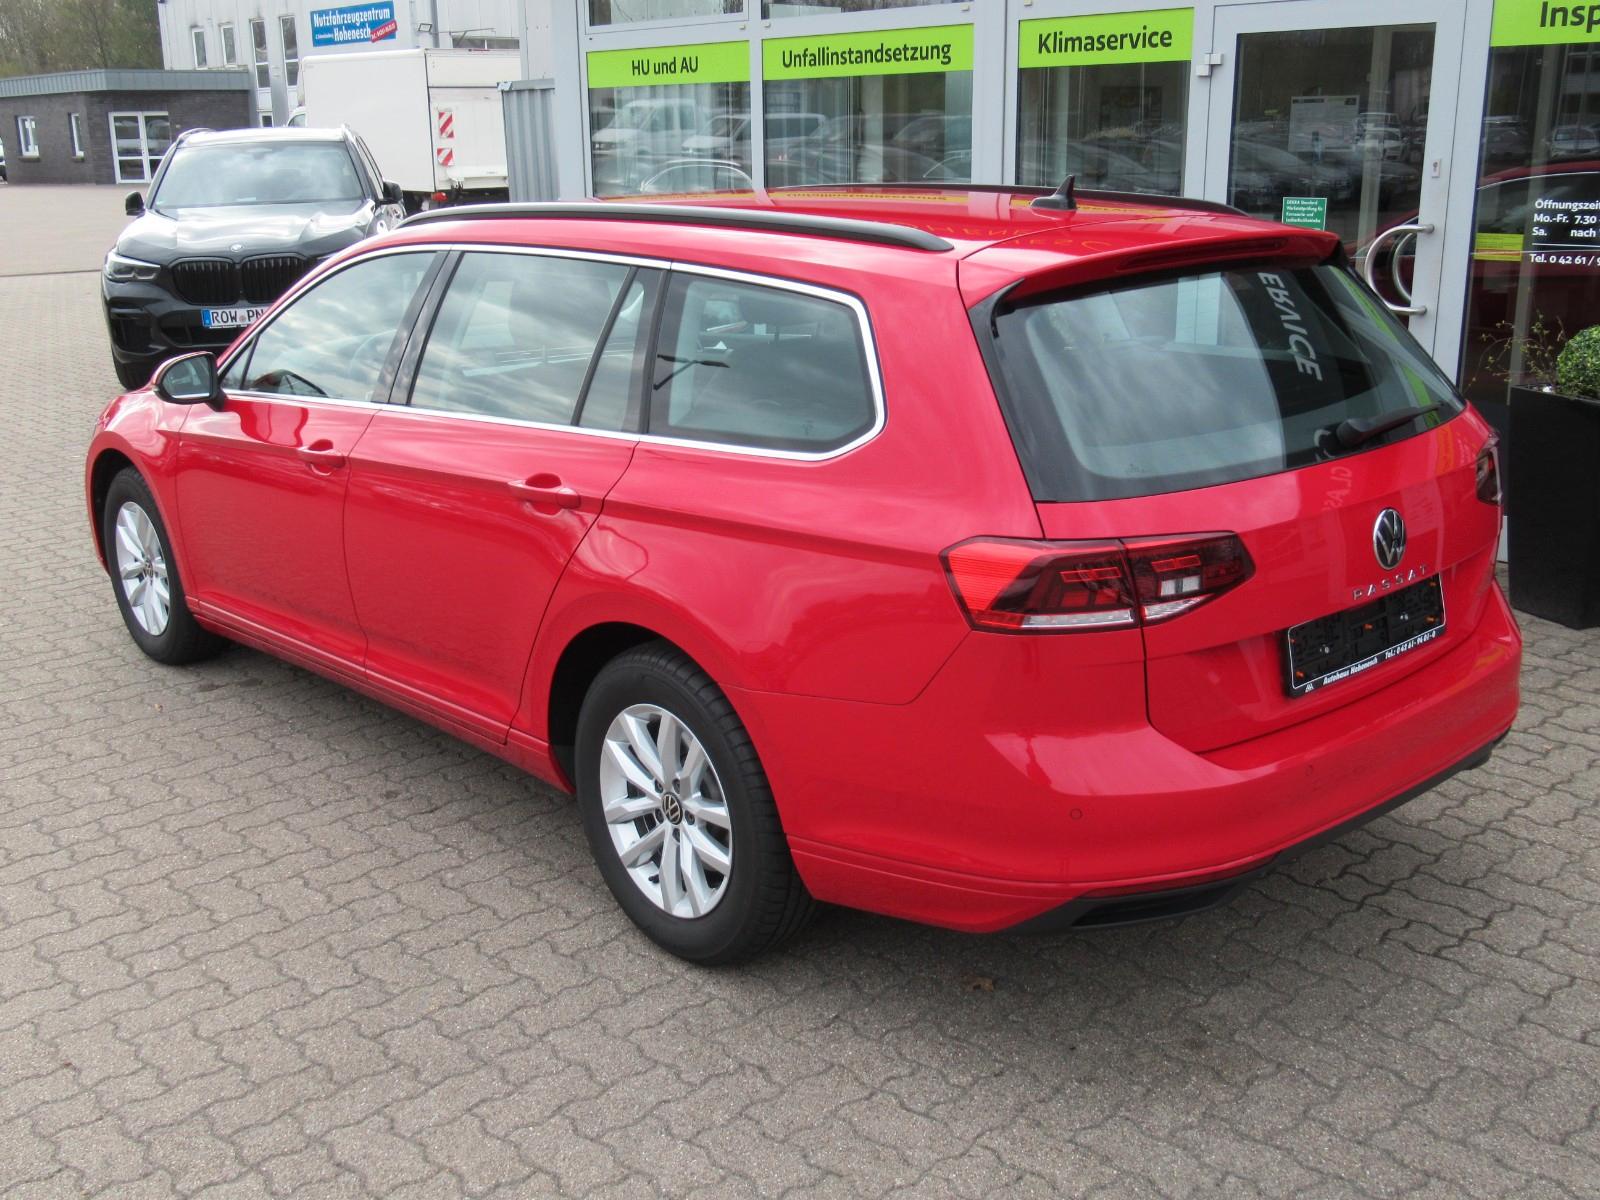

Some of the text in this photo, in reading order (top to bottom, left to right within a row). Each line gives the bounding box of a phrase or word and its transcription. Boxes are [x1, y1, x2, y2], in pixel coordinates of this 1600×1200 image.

[313, 8, 391, 27] Nutzfahrzeugzentrum
[334, 23, 371, 42] Hohenesch
[1038, 25, 1172, 54] Klimaservice
[782, 43, 952, 68] Unfallinstandsetzung
[632, 56, 699, 76] HU und AU
[1535, 199, 1600, 212] Öffnungszei
[1533, 213, 1597, 225] Mo.-Fr. 7.30
[1532, 227, 1596, 237] Sa. nach
[1530, 253, 1547, 263] Tel.
[1558, 255, 1572, 264] 42
[1574, 255, 1586, 264] 61
[211, 310, 238, 324] ROW
[1353, 565, 1427, 600] PASSAT
